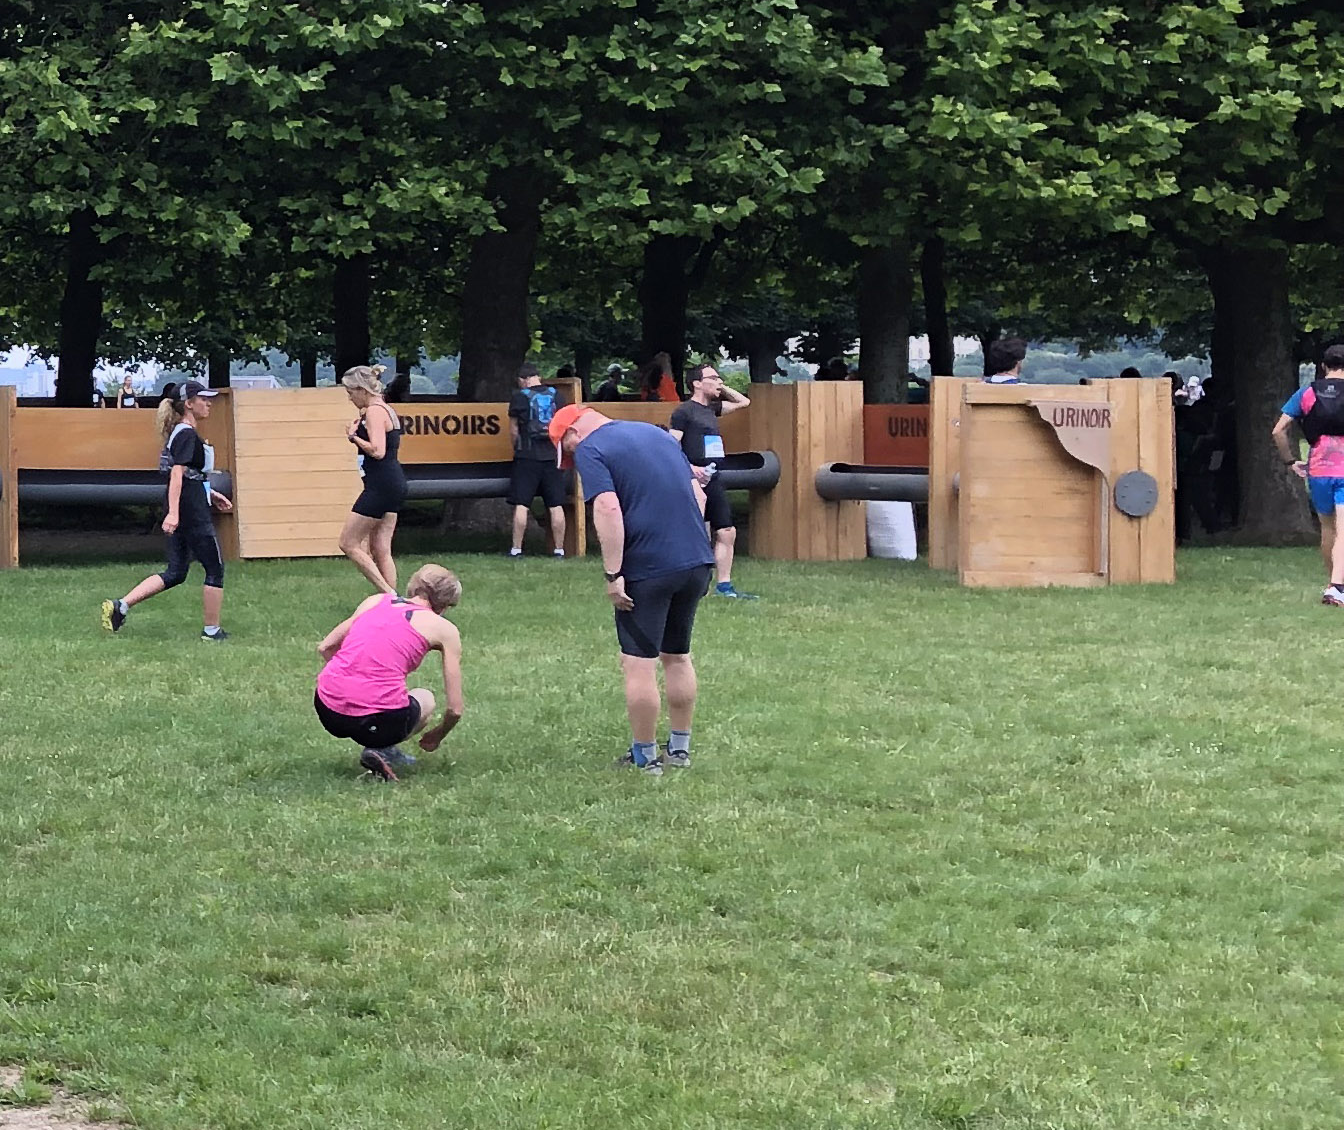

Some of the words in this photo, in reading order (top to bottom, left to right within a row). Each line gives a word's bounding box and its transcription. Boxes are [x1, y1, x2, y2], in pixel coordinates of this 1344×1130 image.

[398, 415, 500, 435] RINOIRS
[888, 417, 928, 437] URIN
[1053, 408, 1111, 428] URINOIR
